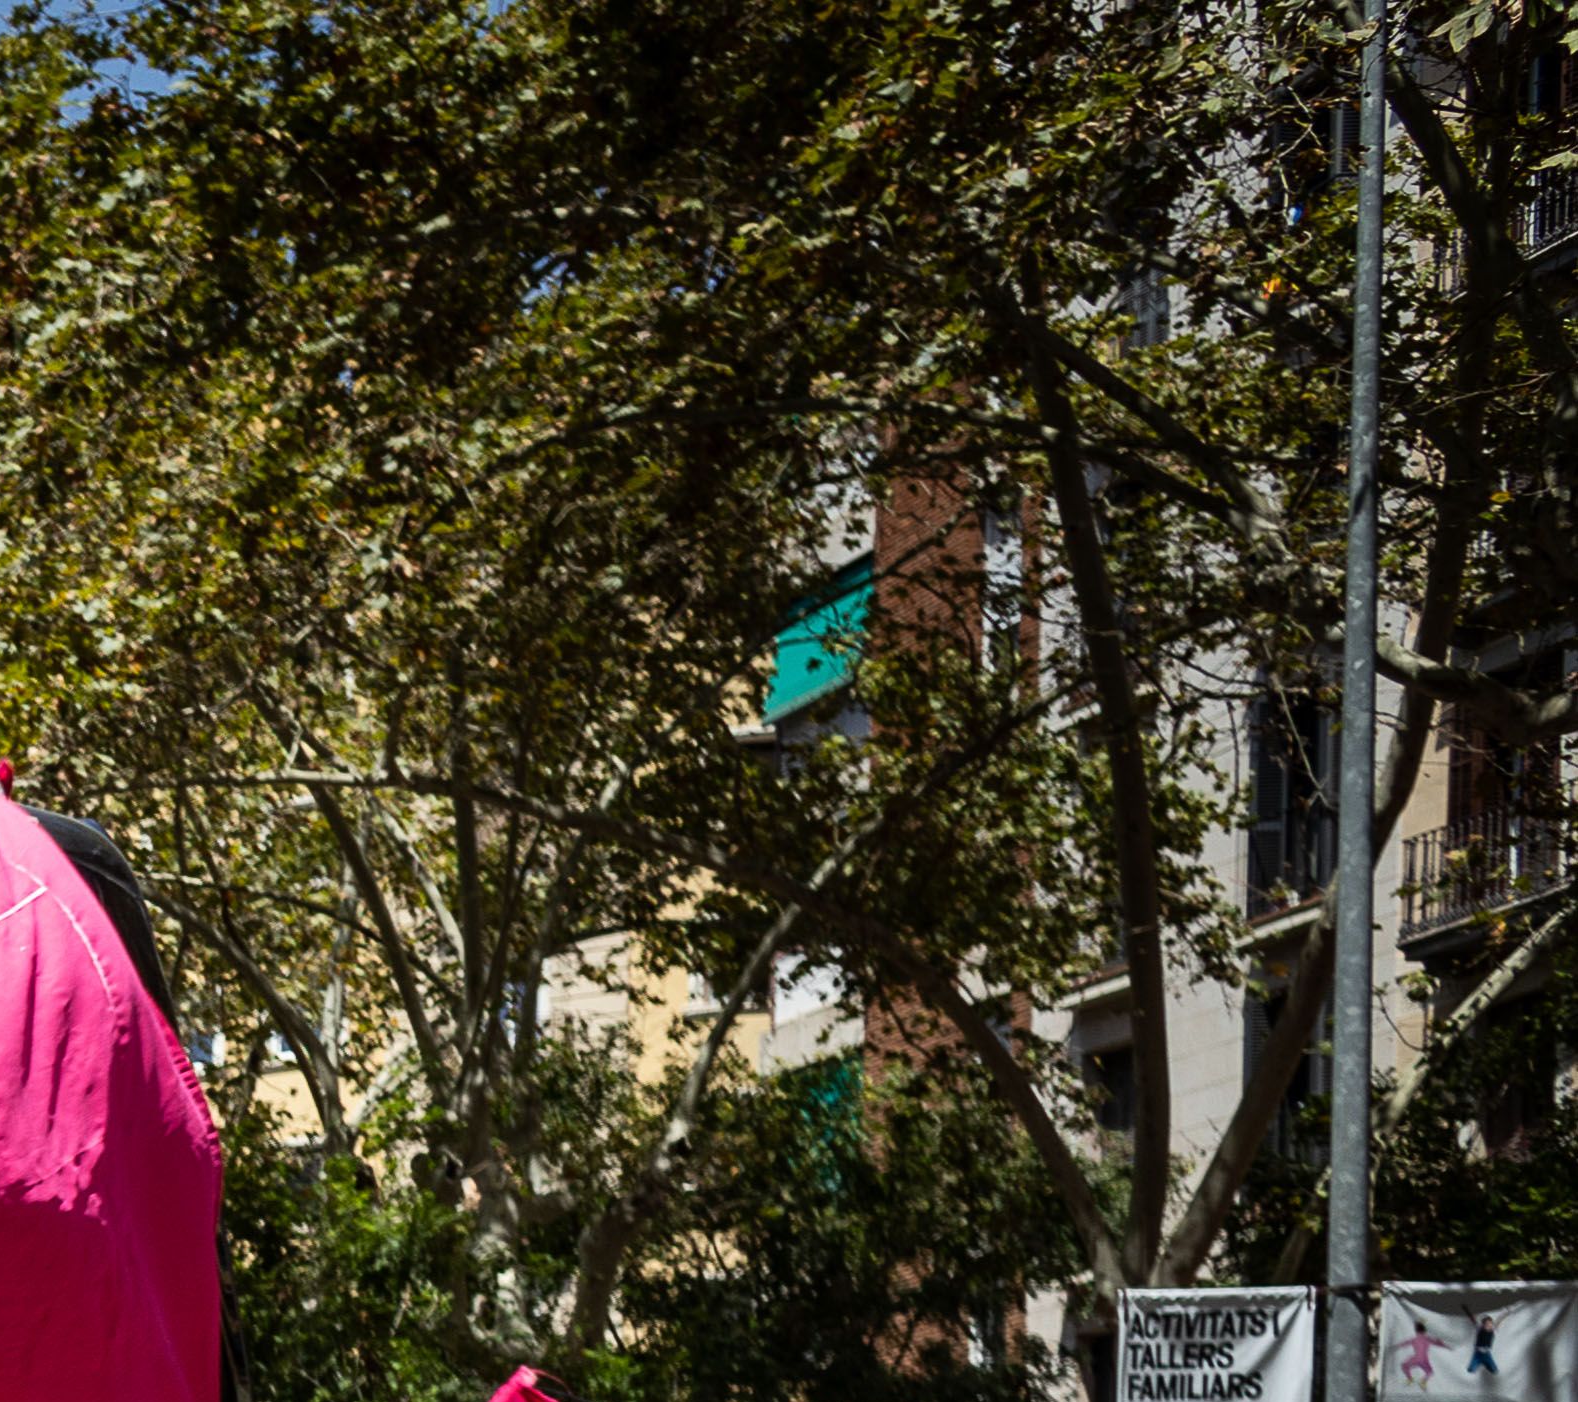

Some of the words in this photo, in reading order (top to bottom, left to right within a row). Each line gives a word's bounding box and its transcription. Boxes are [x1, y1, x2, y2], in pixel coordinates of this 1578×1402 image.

[1128, 1308, 1267, 1339] ACTIVITATS
[1128, 1341, 1235, 1371] TALLERS
[1127, 1370, 1264, 1401] FAMILIARS
